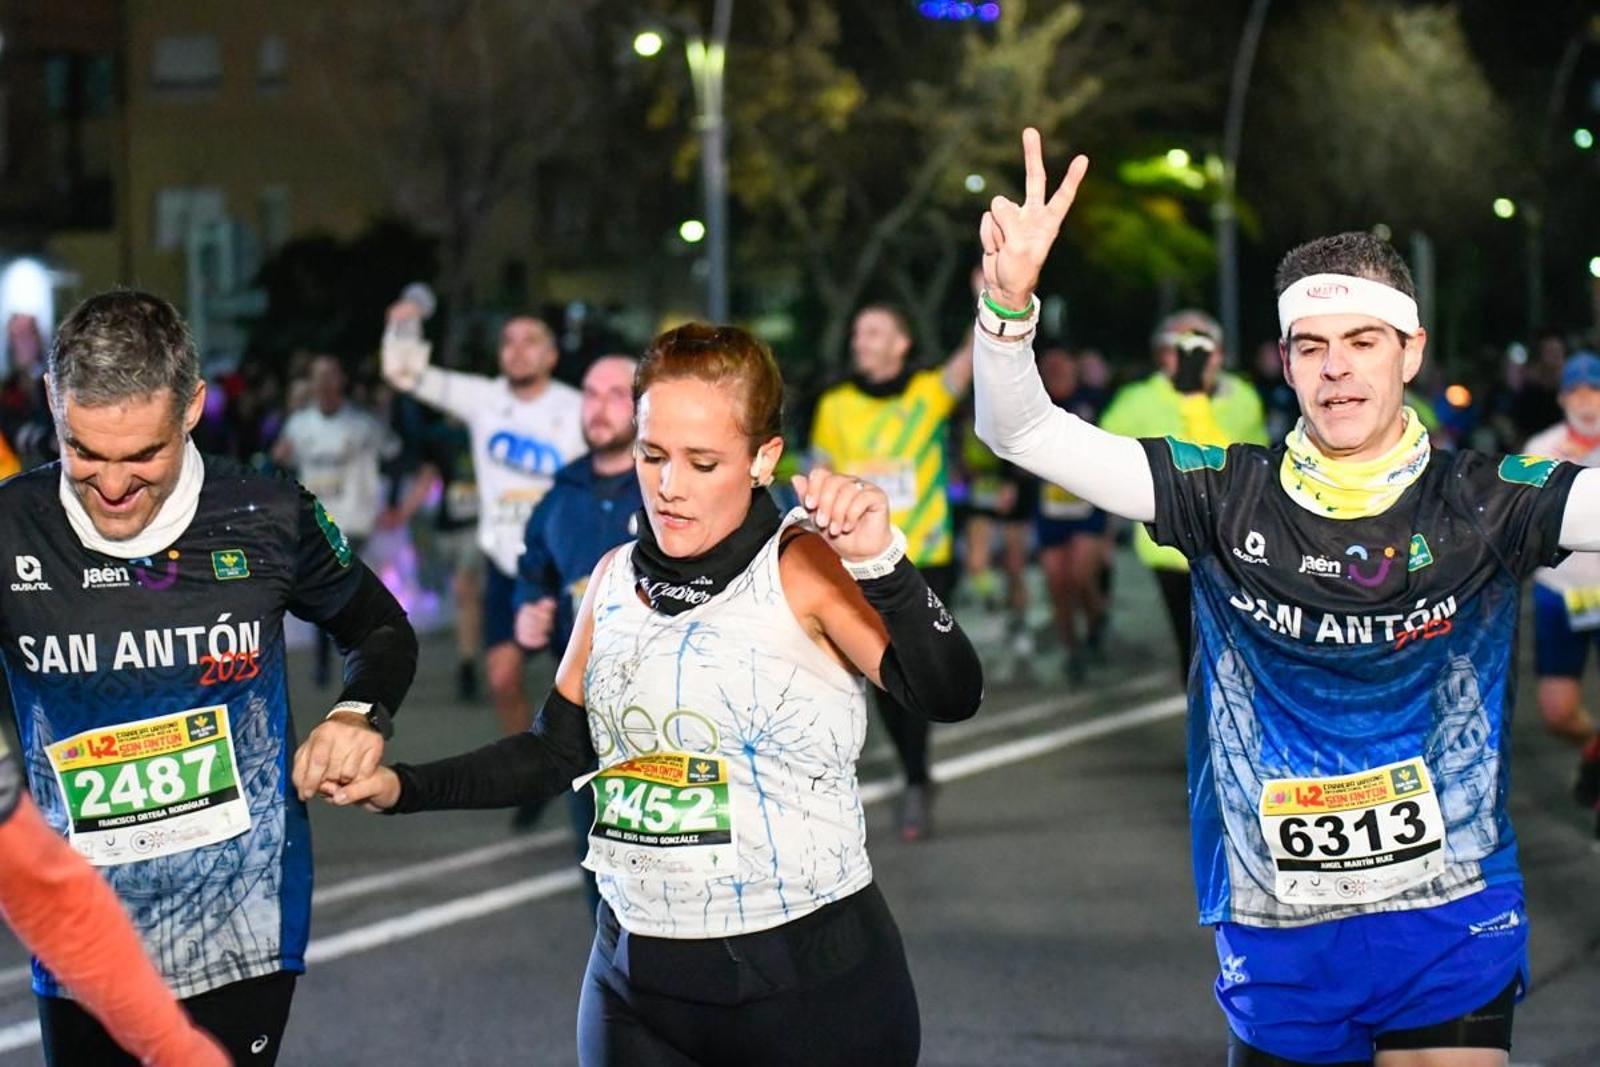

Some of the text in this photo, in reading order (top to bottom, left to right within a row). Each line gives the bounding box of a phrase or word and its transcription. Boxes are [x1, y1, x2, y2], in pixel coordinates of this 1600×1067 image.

[1229, 585, 1458, 644] SAN ANTÓN
[18, 613, 261, 674] SAN ANTÓN
[199, 651, 262, 686] 2025
[87, 736, 118, 758] 42
[74, 744, 218, 817] 2487
[1295, 785, 1325, 807] 42
[98, 815, 136, 827] FRANCISCO
[136, 809, 167, 821] ORTEGA
[1279, 800, 1427, 858] 6313
[660, 834, 700, 845] GONZÁLEZ
[1343, 857, 1375, 868] MARTÍN
